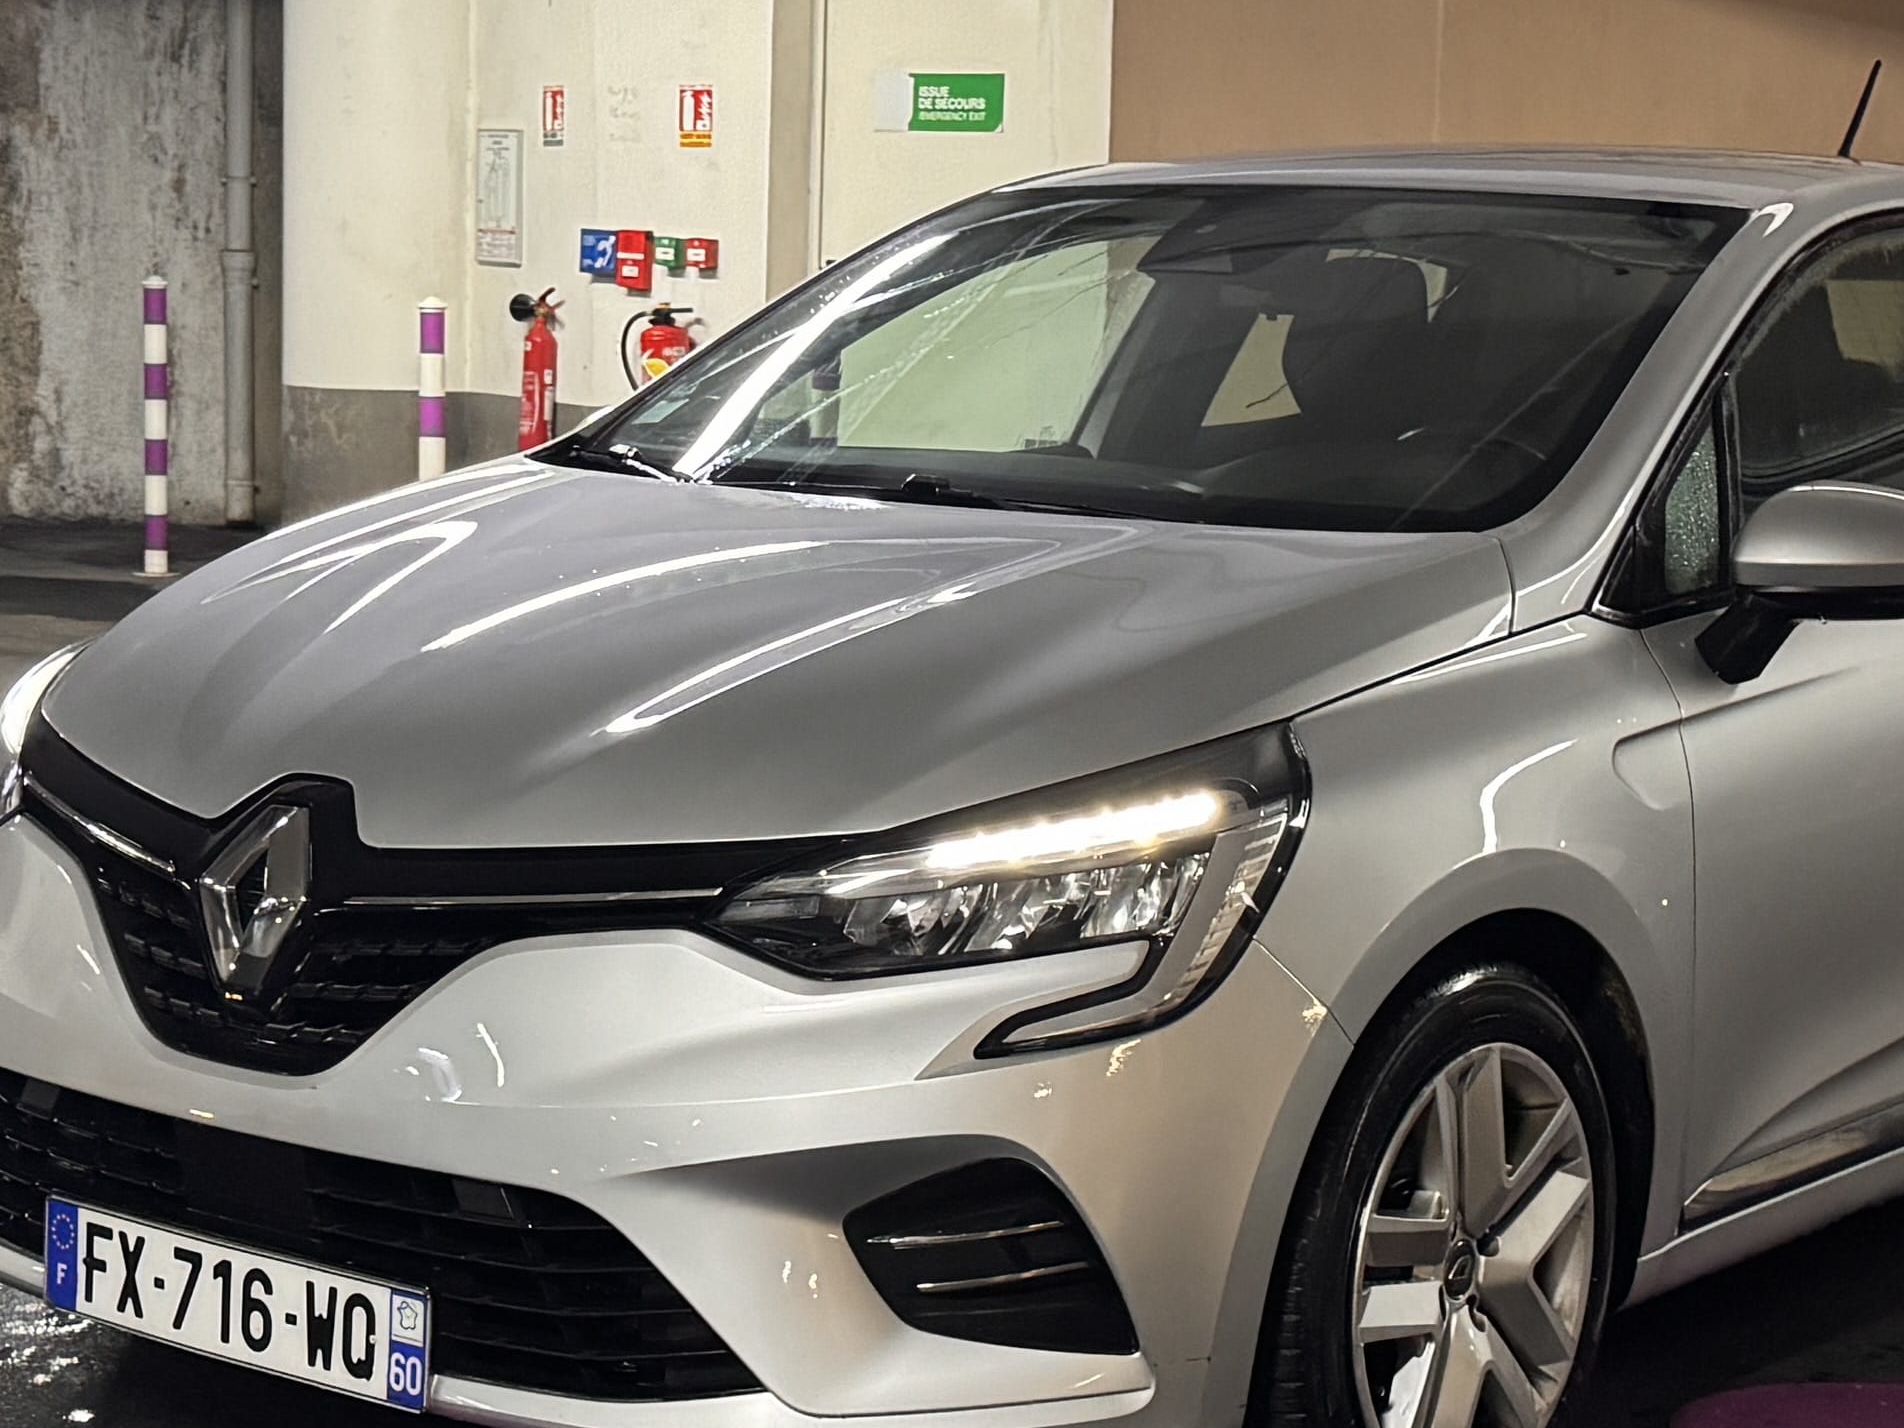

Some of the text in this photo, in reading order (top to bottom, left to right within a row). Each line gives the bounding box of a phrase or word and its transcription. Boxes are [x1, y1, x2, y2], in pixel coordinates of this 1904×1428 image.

[918, 98, 933, 109] DE
[919, 86, 949, 97] ISSUE
[56, 1262, 68, 1286] F
[82, 1221, 377, 1381] FX-716-WQ
[389, 1351, 422, 1396] 60
